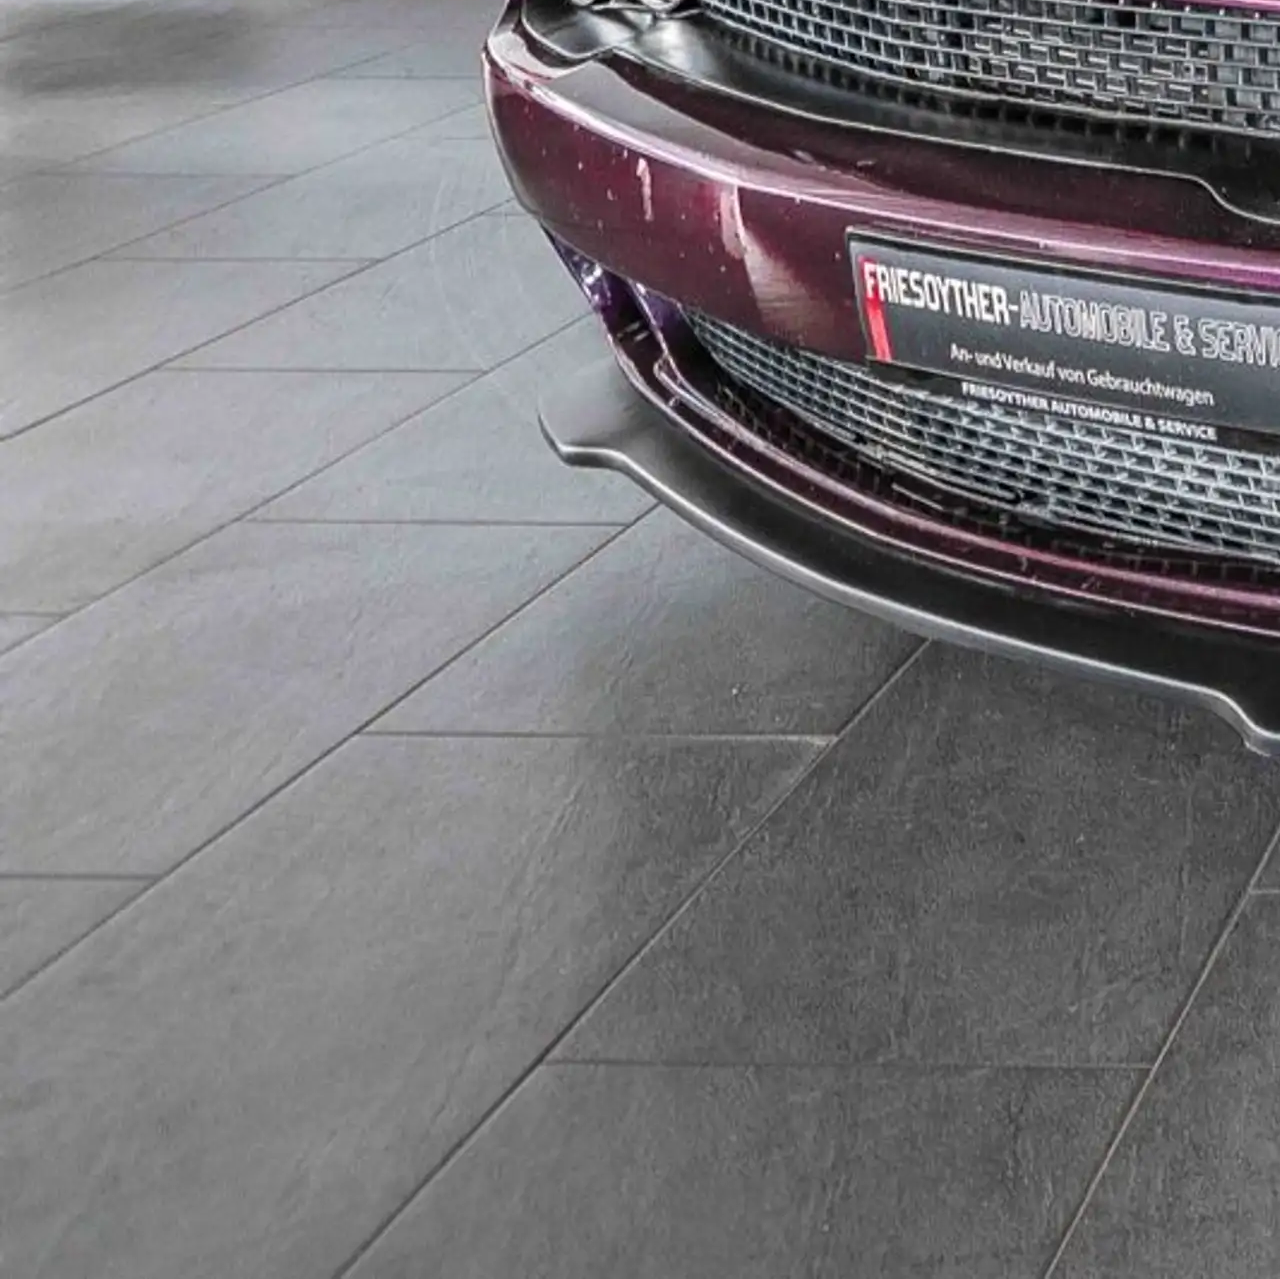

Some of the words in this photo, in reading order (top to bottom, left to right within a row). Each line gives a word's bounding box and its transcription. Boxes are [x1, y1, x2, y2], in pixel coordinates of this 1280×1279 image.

[863, 261, 1170, 353] FRIESOYTHER-AUTOMOBILE
[1173, 313, 1197, 357] &
[950, 342, 974, 364] An-
[975, 350, 1002, 370] und
[1003, 354, 1056, 380] Verkauf
[1058, 366, 1086, 385] von
[1087, 368, 1215, 408] Gebrauchtwagen
[960, 381, 1049, 411] FRIESOYTHER
[1051, 400, 1143, 429] AUTOMOBILE
[1157, 418, 1218, 442] SERVICE
